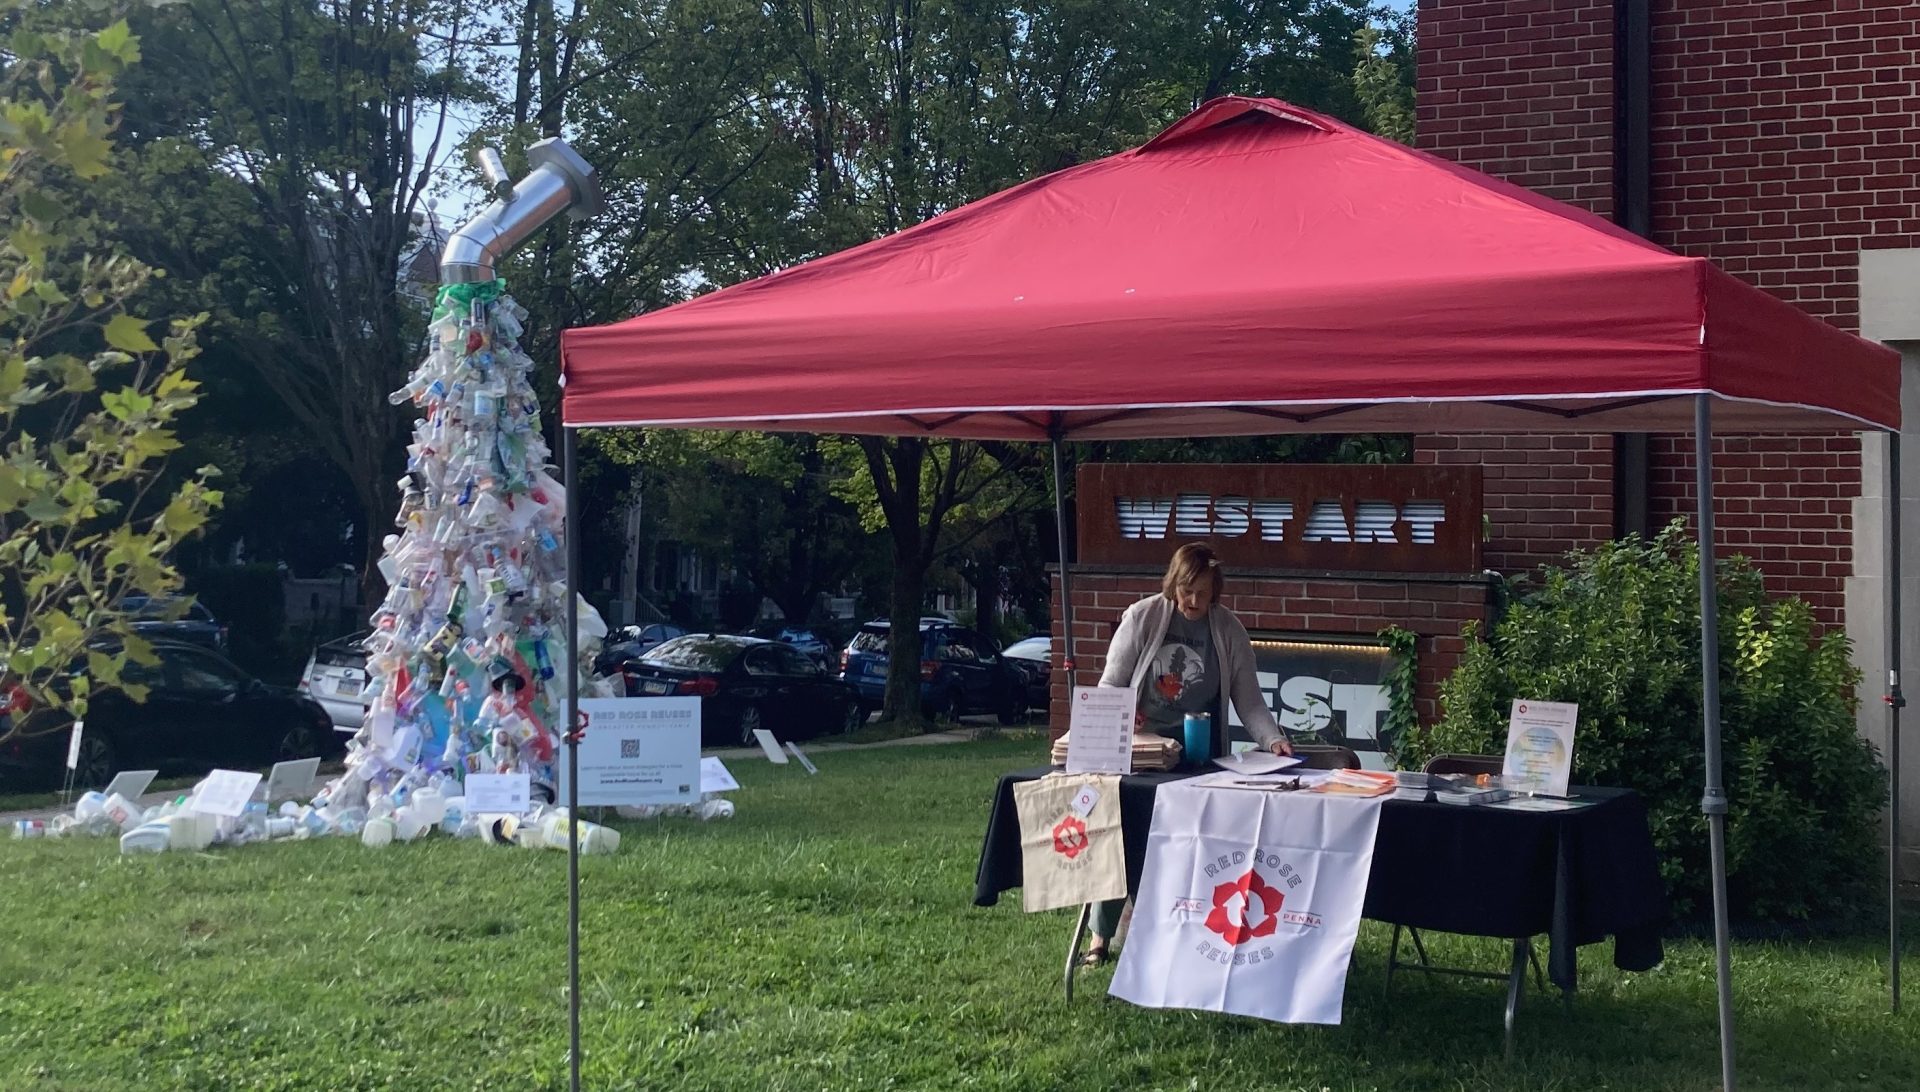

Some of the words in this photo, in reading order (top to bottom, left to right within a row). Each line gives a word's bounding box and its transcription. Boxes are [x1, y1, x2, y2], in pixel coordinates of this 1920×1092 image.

[1116, 493, 1293, 541] WEST
[1302, 499, 1445, 544] ART
[594, 711, 616, 720] RED
[619, 710, 648, 720] ROSE
[1204, 851, 1246, 878] RED
[1254, 848, 1302, 889] ROSE
[1283, 913, 1321, 925] PENNA
[1196, 940, 1275, 966] REUSES
